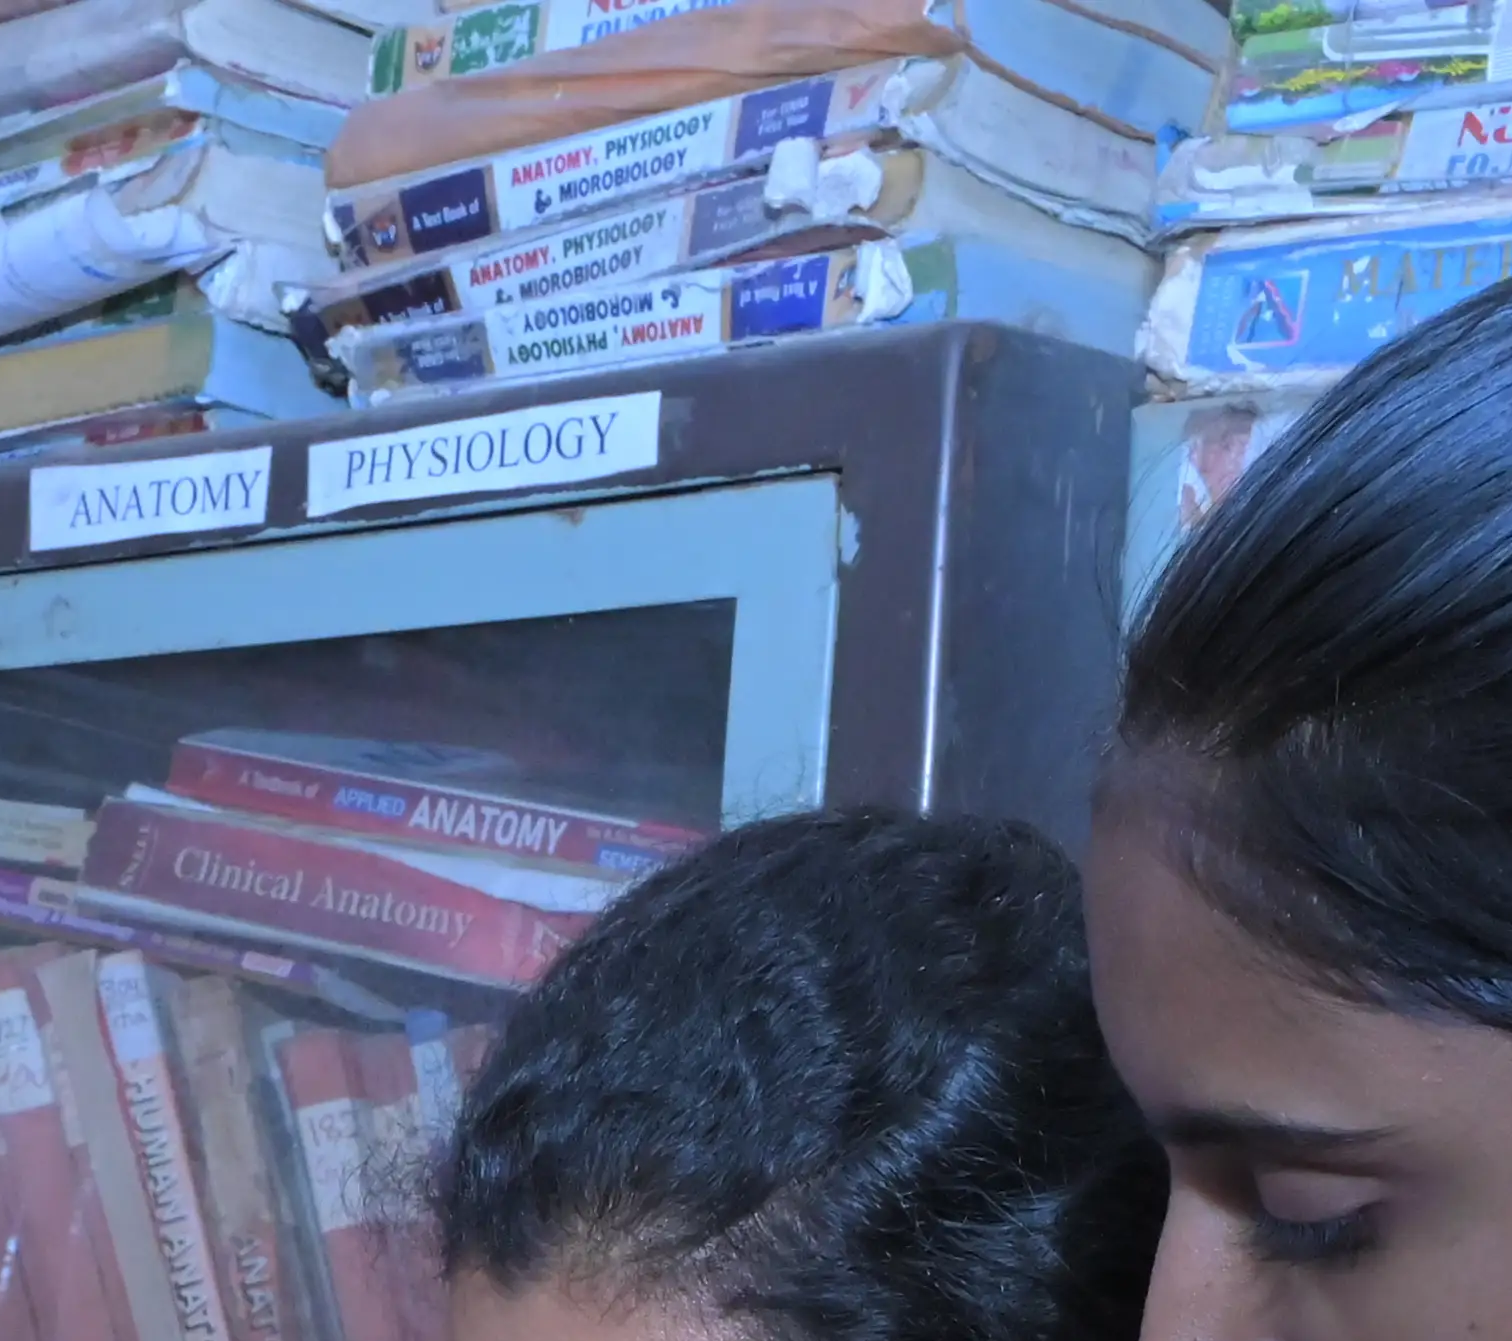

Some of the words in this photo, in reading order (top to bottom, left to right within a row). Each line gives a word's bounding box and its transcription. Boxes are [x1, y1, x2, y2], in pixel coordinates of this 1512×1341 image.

[605, 112, 714, 161] PHYSIOLOGY
[562, 208, 667, 259] PHYSIOLOGY
[344, 413, 620, 490] PHYSIOLOGY
[69, 469, 263, 530] ANATOMY
[408, 796, 569, 856] ANATOMY
[173, 845, 305, 904] Clinical
[309, 874, 475, 947] Anatomy
[125, 1071, 190, 1226] HUMAN
